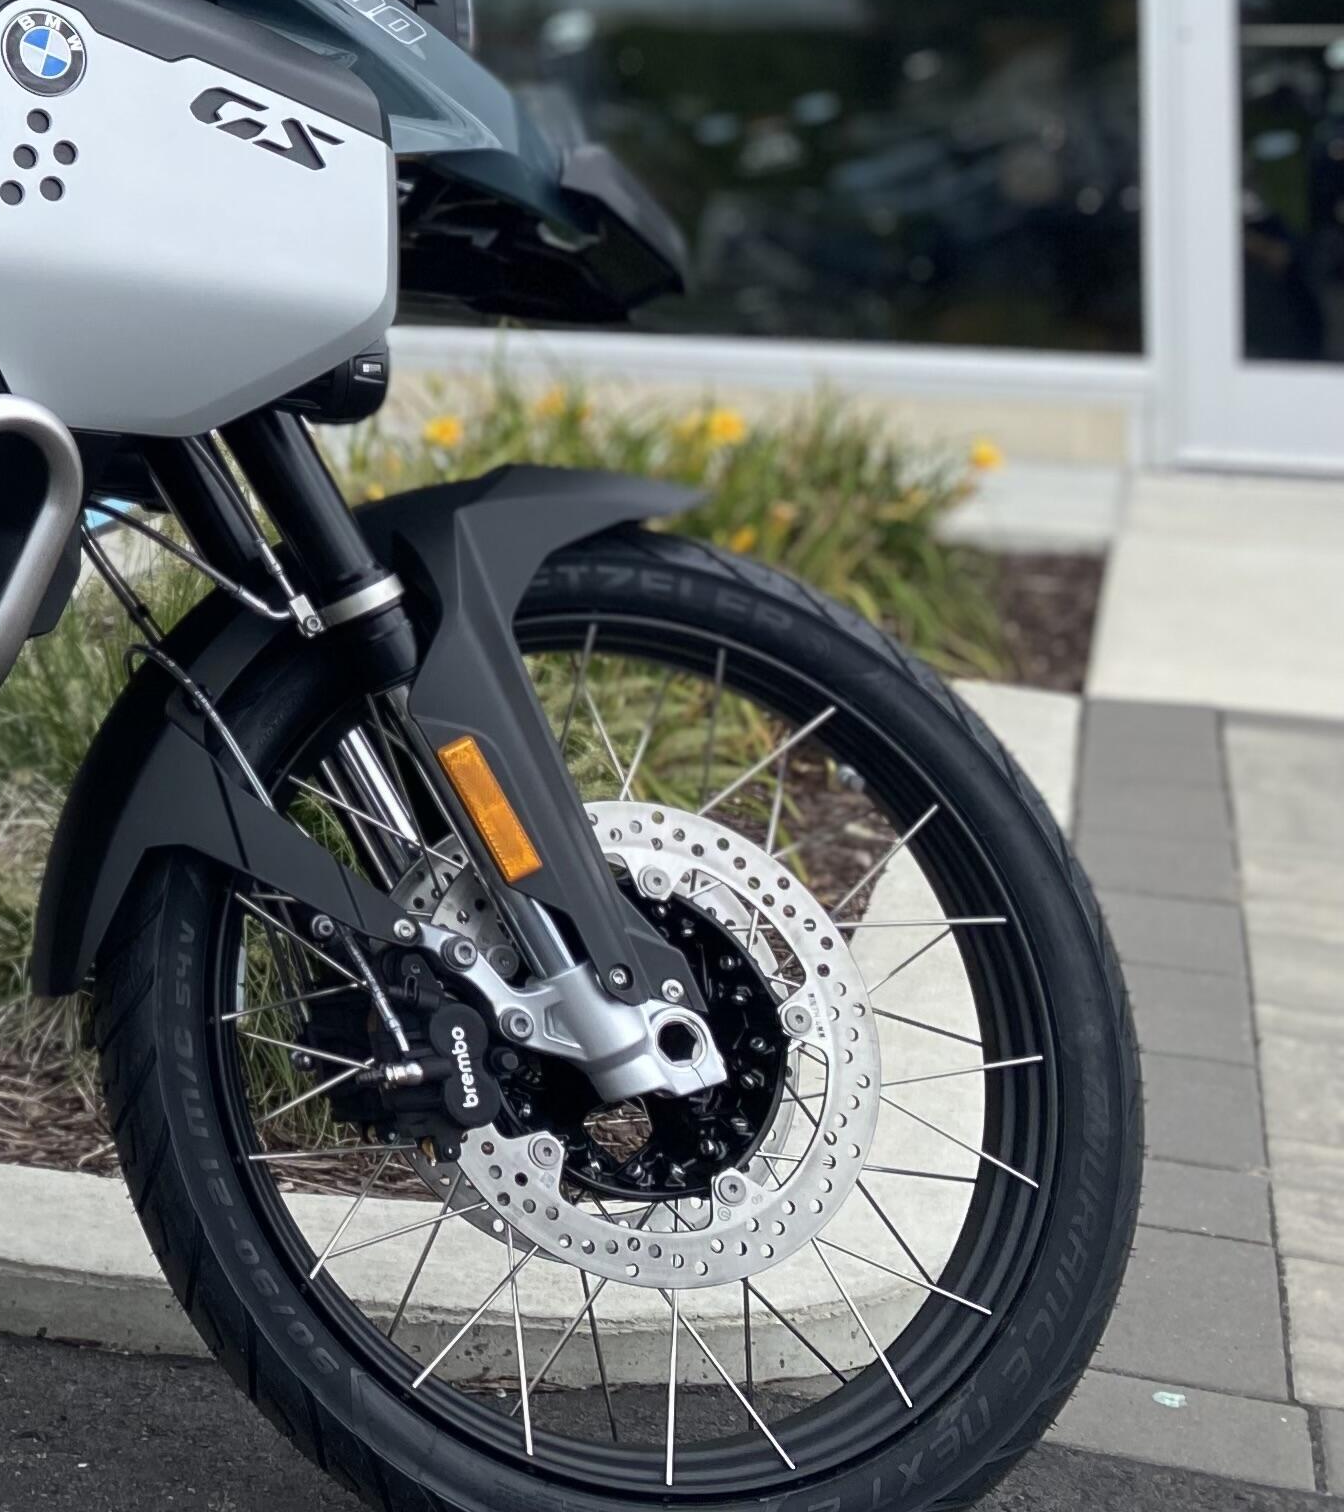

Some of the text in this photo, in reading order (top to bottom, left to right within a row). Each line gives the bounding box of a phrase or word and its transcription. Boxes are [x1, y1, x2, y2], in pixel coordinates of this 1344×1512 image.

[17, 13, 84, 51] BMW
[189, 86, 345, 171] GS
[451, 1026, 479, 1108] brembo
